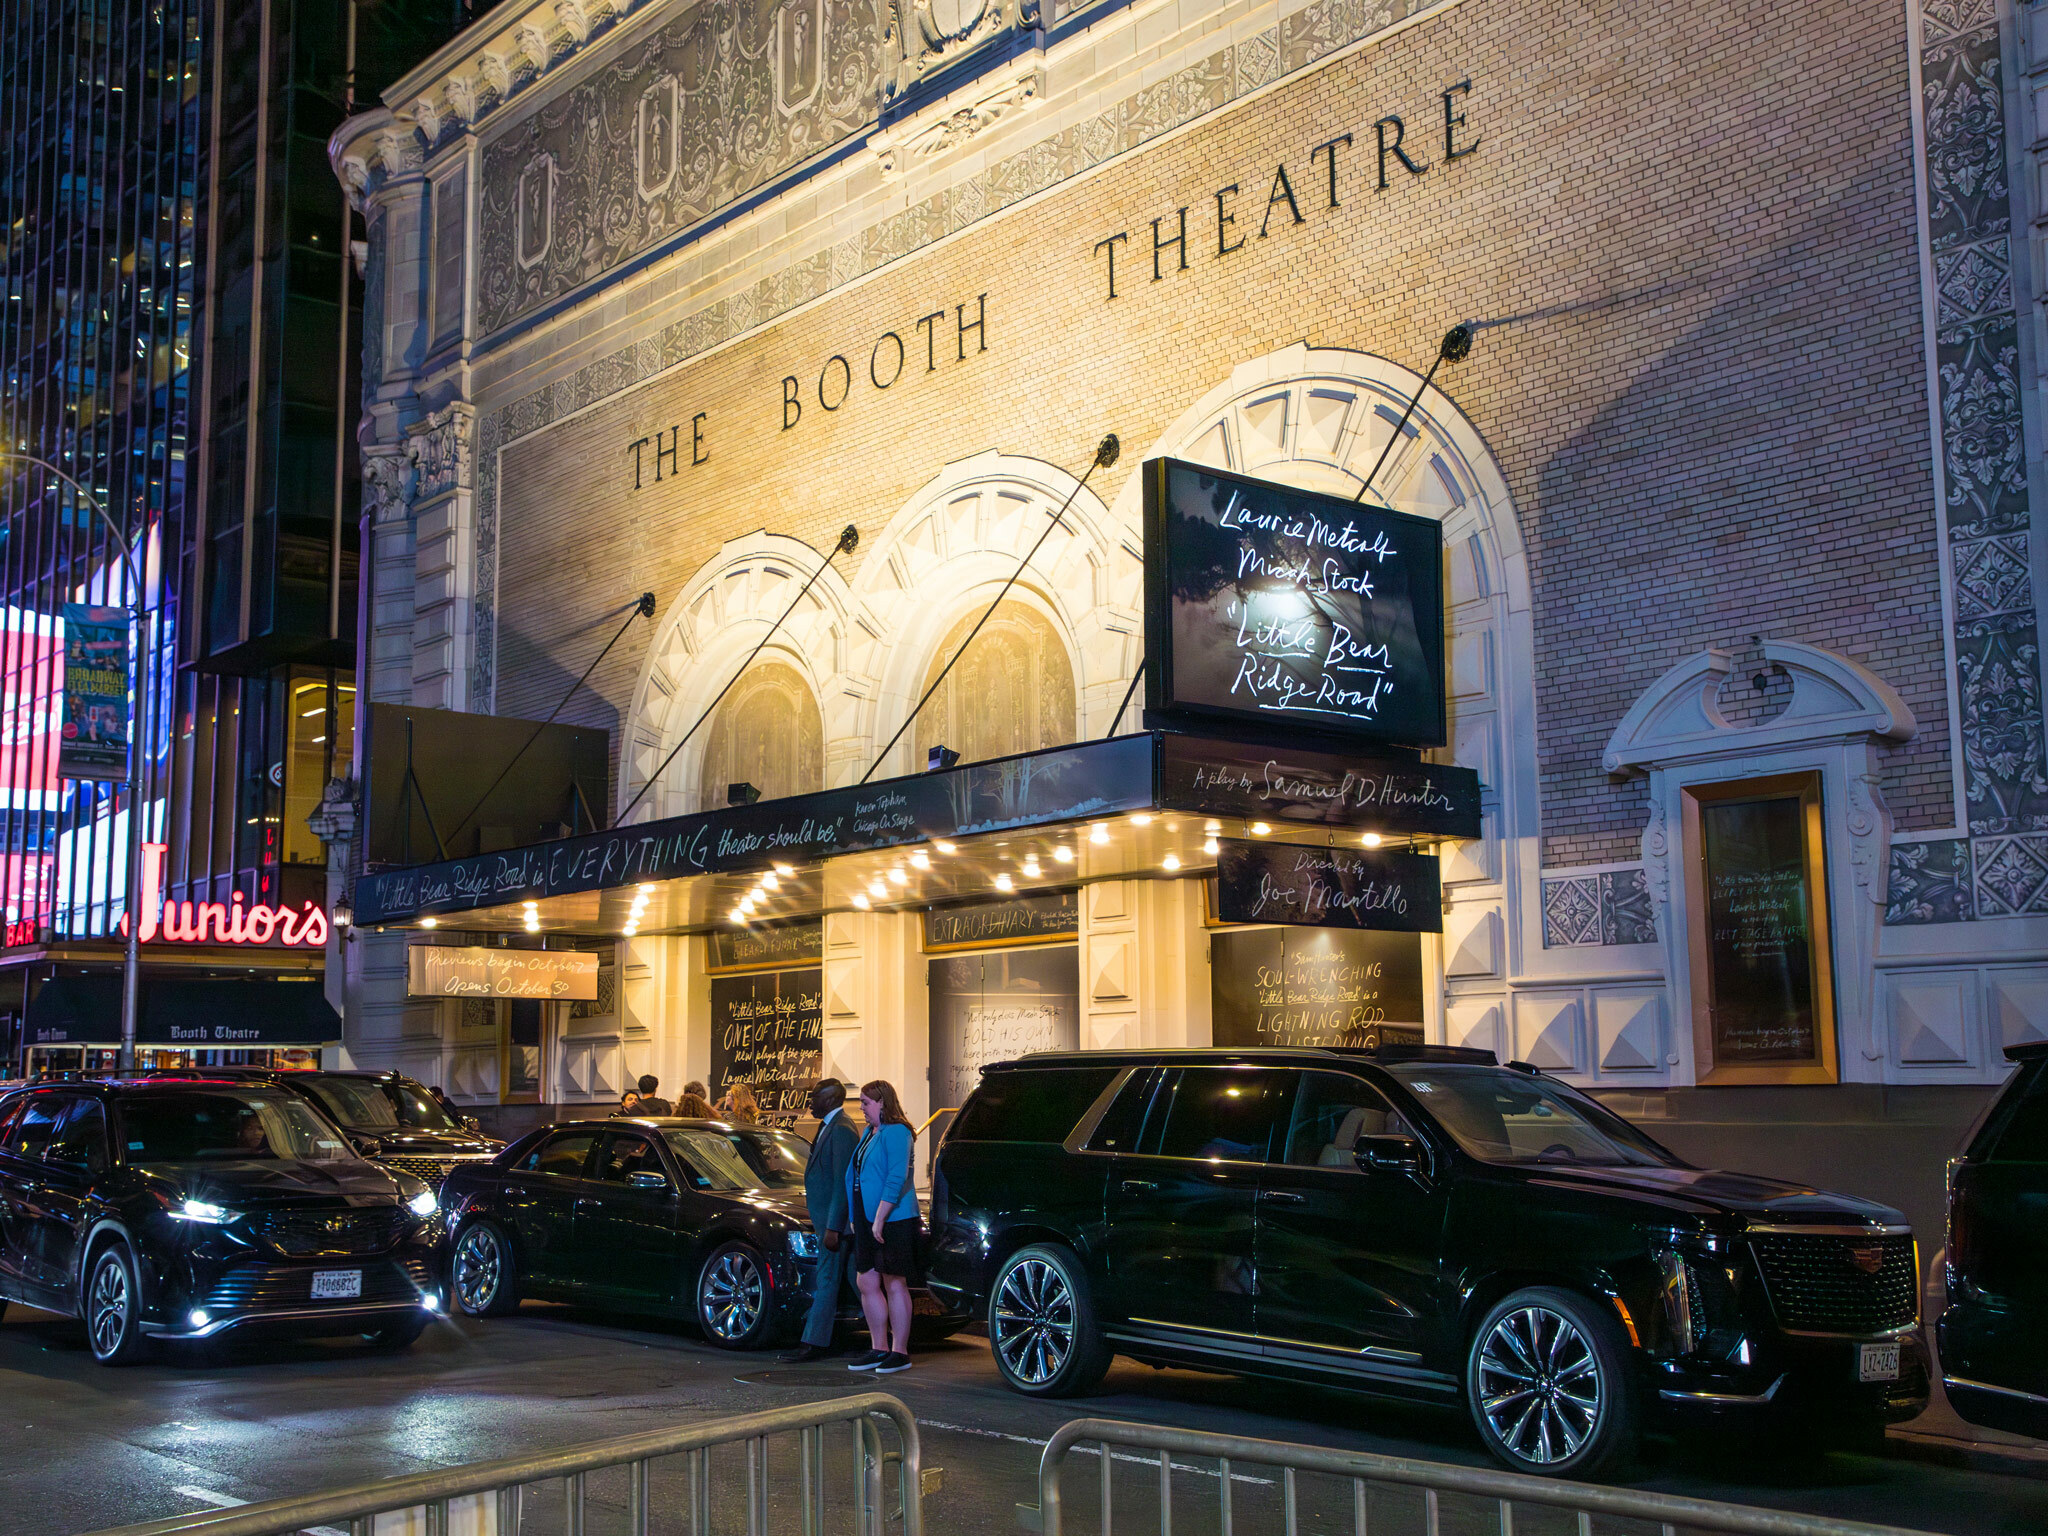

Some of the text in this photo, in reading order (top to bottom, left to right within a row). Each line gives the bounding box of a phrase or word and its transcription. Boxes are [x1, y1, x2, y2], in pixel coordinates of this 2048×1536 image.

[627, 79, 1481, 491] THE BOOTH THEATRE
[1220, 489, 1397, 563] Laurie Metcalf
[1238, 547, 1374, 599] Micah Stock
[1227, 601, 1392, 670] "Little Bear
[68, 667, 125, 685] BROADWAY
[1231, 652, 1393, 713] Ridge Road"
[1193, 760, 1454, 811] A play by Samuel D. Hunter
[891, 813, 915, 831] Stage
[420, 875, 452, 905] Bear
[453, 864, 490, 906] Ridge
[550, 824, 708, 887] EVERYTHING
[717, 829, 765, 857] theater
[766, 819, 812, 847] should
[1294, 852, 1364, 880] Directed by
[120, 842, 328, 945] Junior's
[1252, 872, 1407, 917] Joe Mantello
[6, 921, 35, 948] BAR
[426, 948, 584, 974] Previews begin October 7
[444, 975, 569, 995] Opens October 30
[1255, 962, 1381, 987] SOUL-WRENCHING
[755, 1001, 774, 1017] Bear
[774, 996, 796, 1018] Ridge
[1287, 990, 1310, 1005] Bear
[1309, 987, 1335, 1007] Ridge
[1257, 1006, 1385, 1032] LIGHTNING ROD
[171, 1026, 260, 1040] Booth Theatre
[724, 1023, 752, 1050] ONE
[755, 1021, 771, 1041] OF
[775, 1017, 797, 1040] THE
[963, 1028, 995, 1047] HOLD
[735, 1050, 752, 1063] new
[755, 1045, 776, 1065] plays
[777, 1045, 787, 1065] of
[787, 1048, 799, 1060] the
[721, 1066, 753, 1086] Laurie
[755, 1064, 797, 1086] Metcalf
[799, 1066, 810, 1079] all
[755, 1089, 813, 1112] THE ROOF
